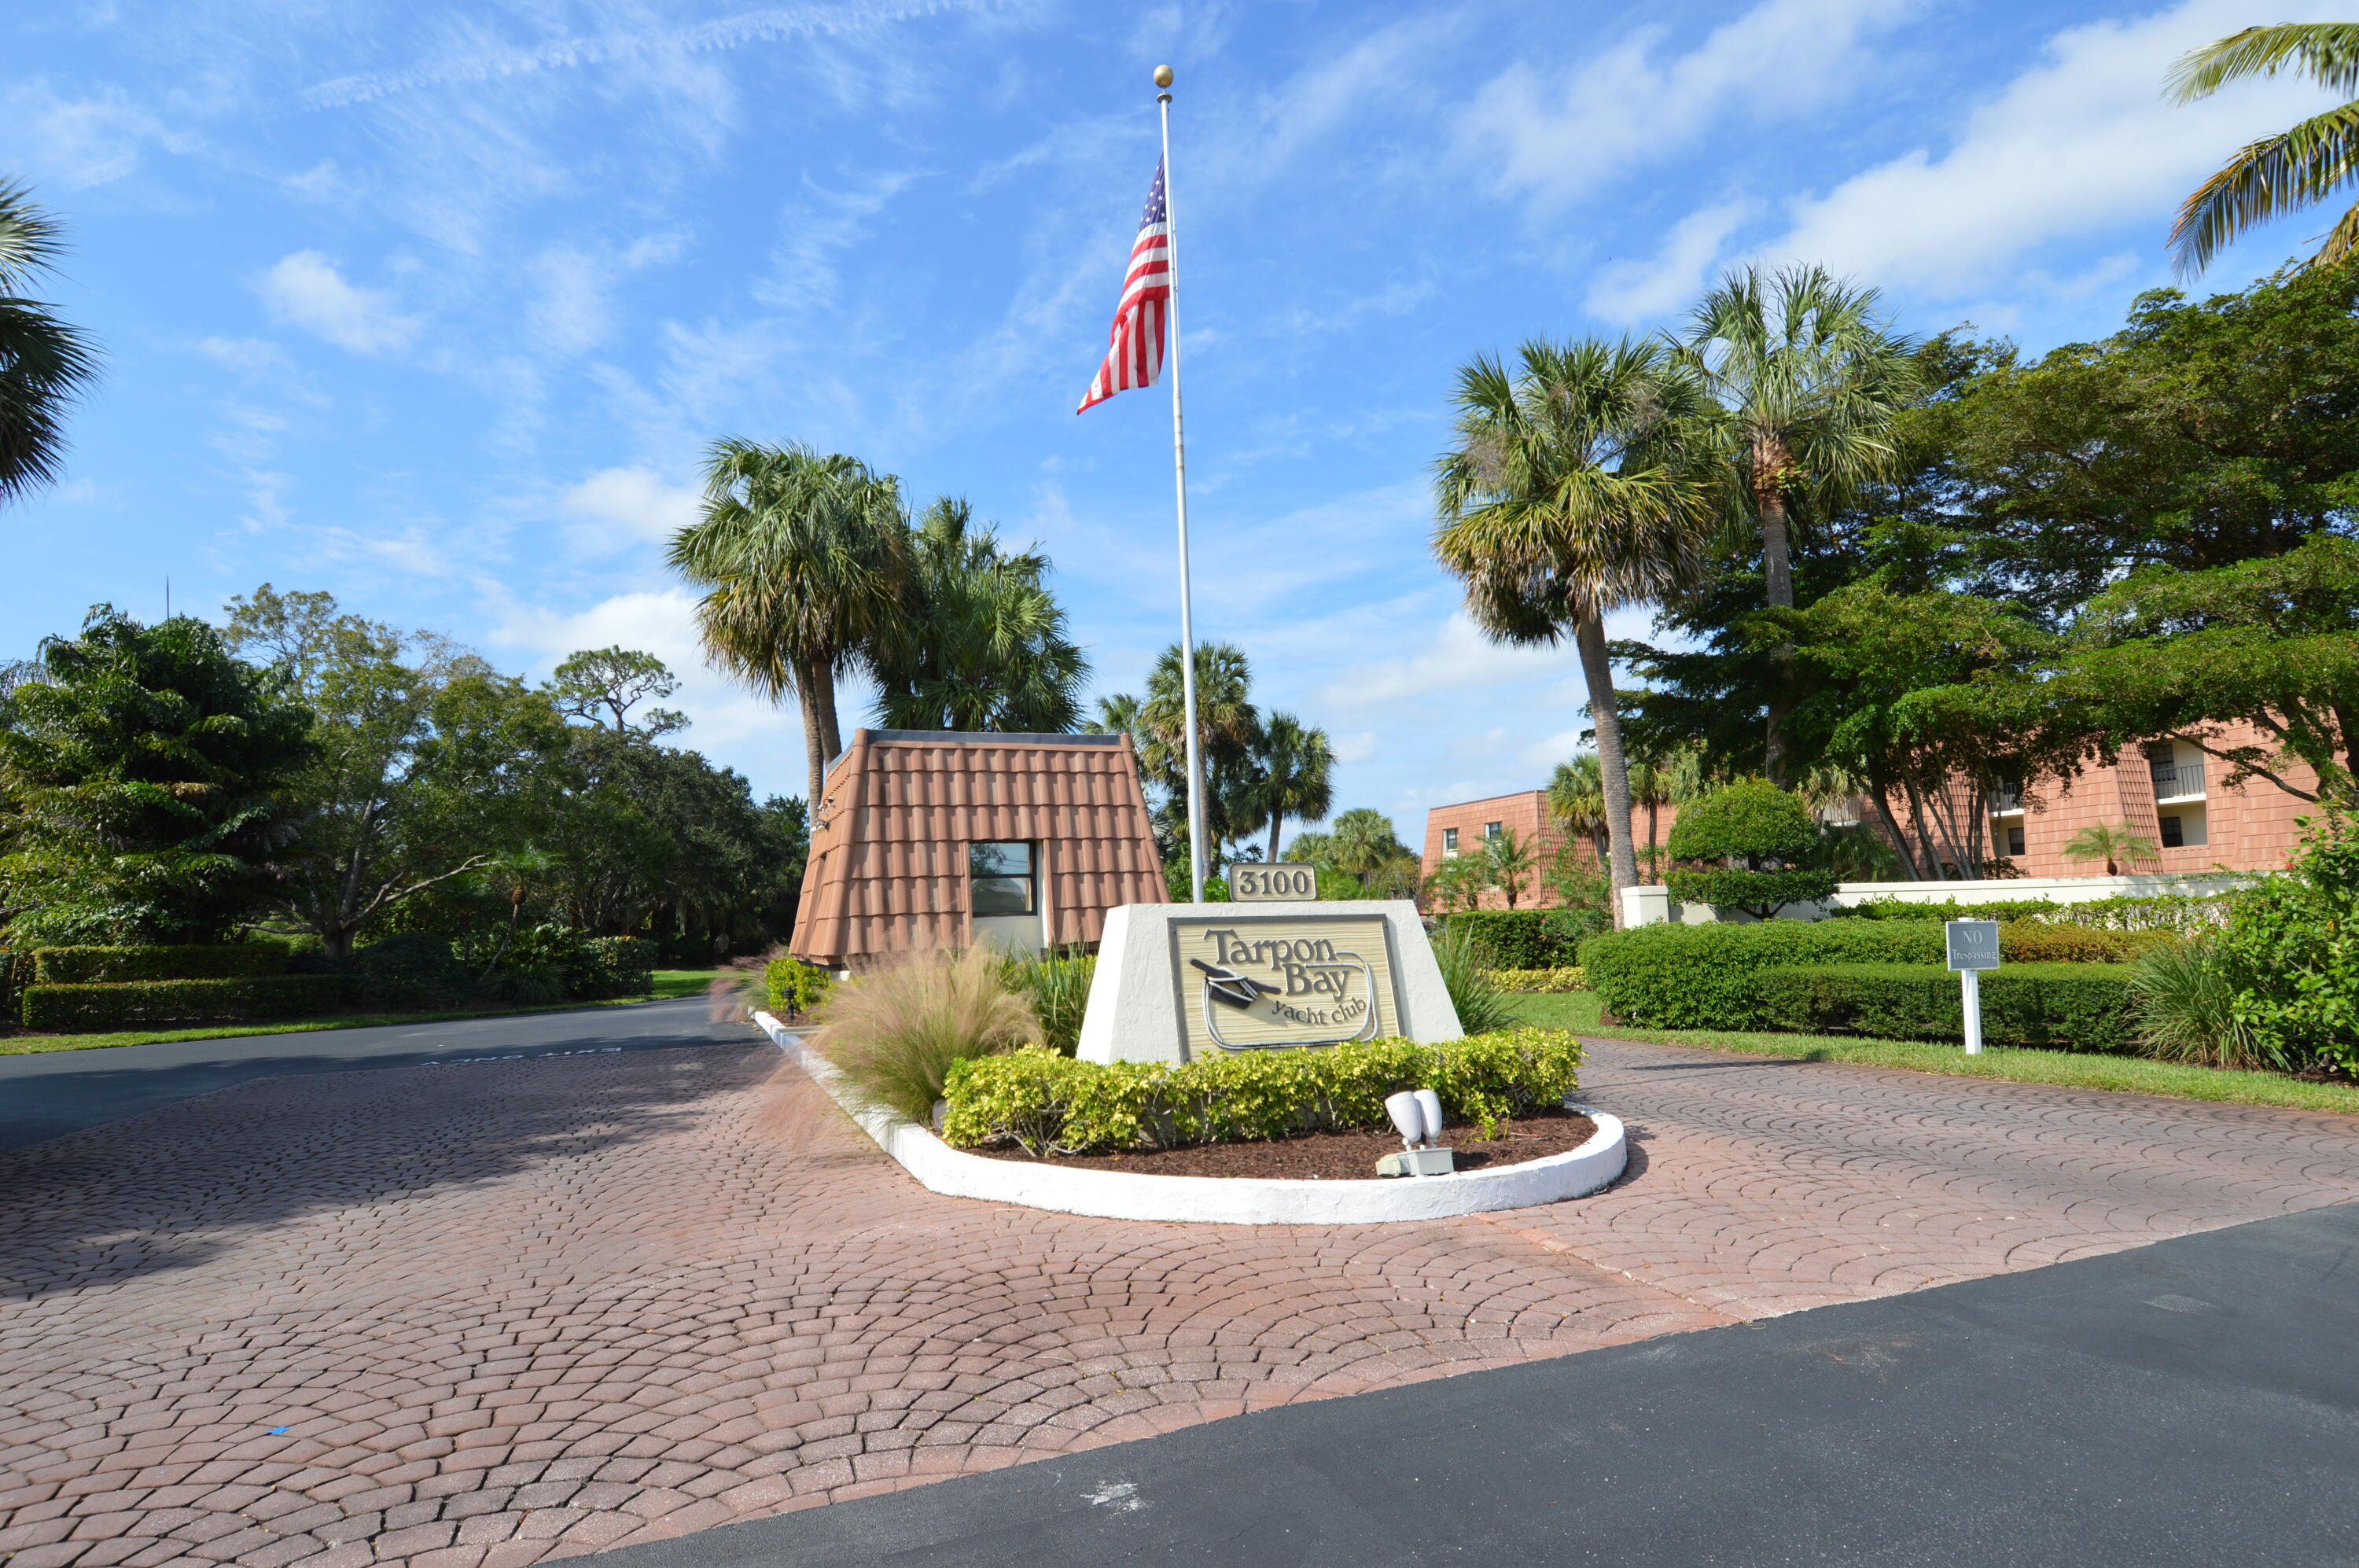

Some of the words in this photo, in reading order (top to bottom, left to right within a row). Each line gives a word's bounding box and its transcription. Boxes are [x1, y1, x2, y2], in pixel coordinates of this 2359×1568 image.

[1239, 870, 1311, 895] 3100
[1963, 930, 1982, 944] NO
[1203, 929, 1338, 970] Tarpon
[1951, 949, 1997, 962] Trespassing
[1283, 963, 1350, 1002] Bay
[1272, 999, 1329, 1025] yacht
[1331, 997, 1367, 1024] club
[421, 1055, 524, 1066] ONLY
[538, 1047, 622, 1057] EXIT
